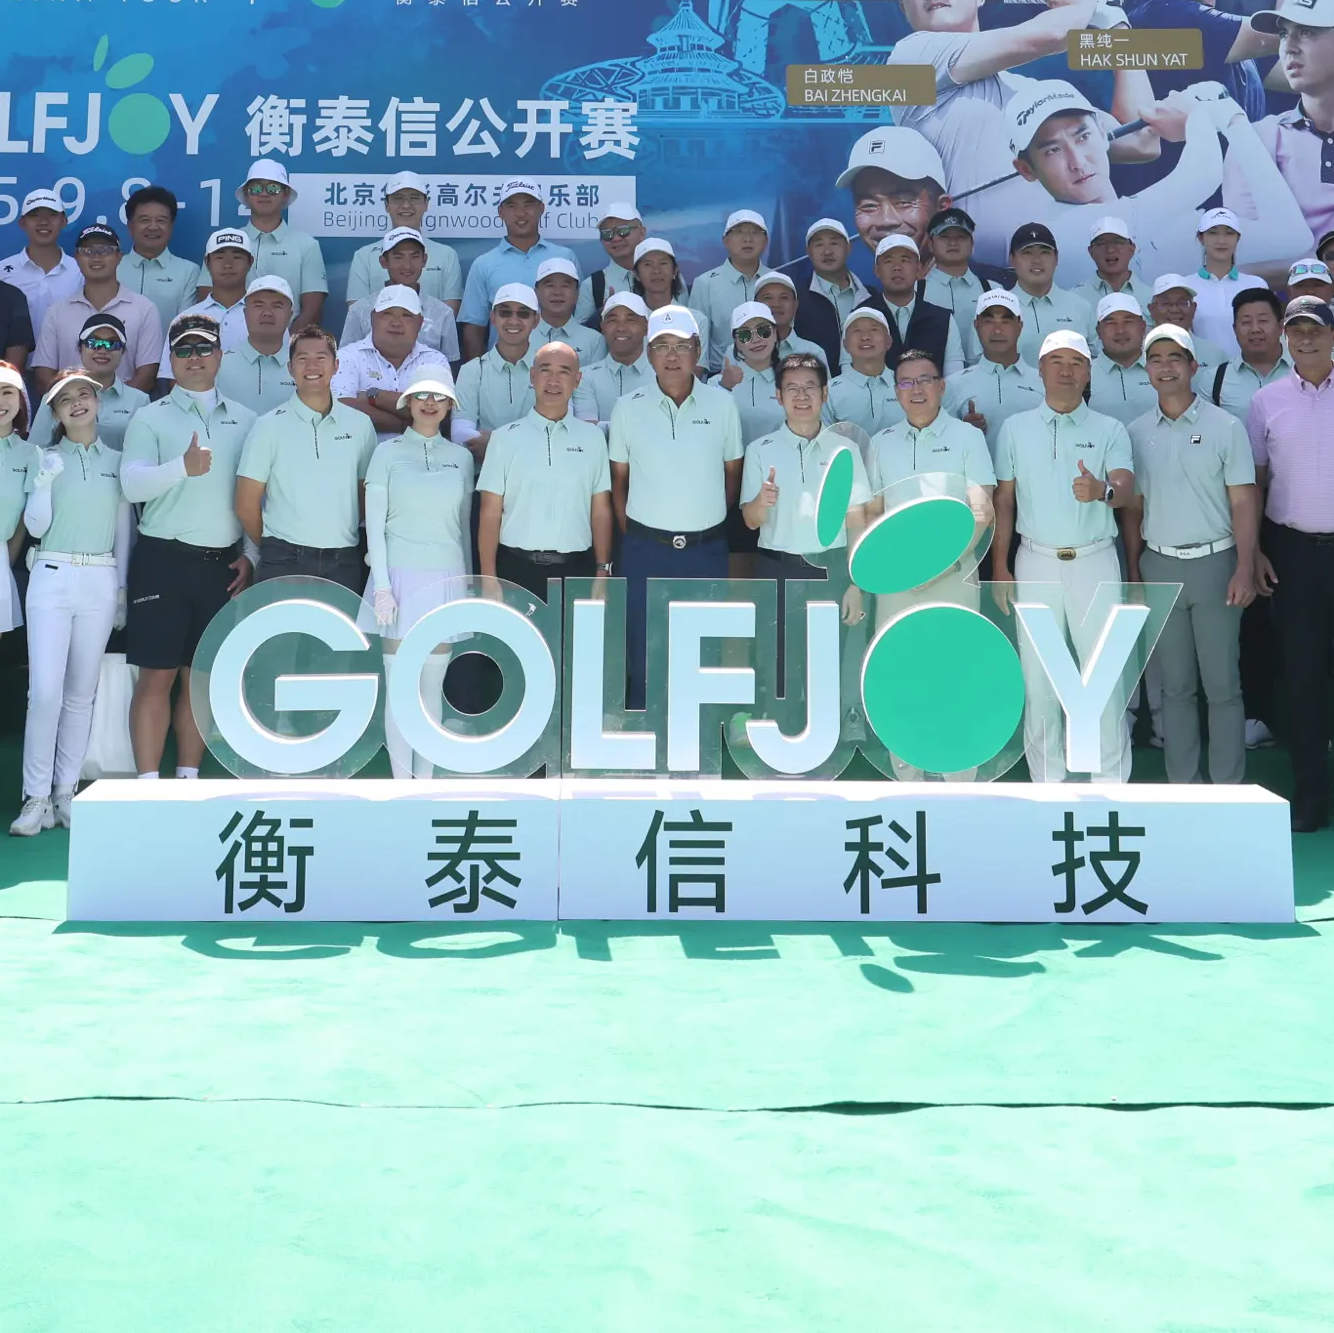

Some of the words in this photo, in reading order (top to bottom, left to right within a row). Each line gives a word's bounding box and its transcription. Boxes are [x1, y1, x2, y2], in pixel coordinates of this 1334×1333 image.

[1079, 33, 1130, 49] 黑纯一
[1079, 53, 1113, 68] HAK
[1116, 53, 1158, 67] SHUN
[1161, 52, 1188, 66] YAT
[804, 69, 854, 85] 白政恺
[804, 89, 829, 103] BAI
[832, 88, 907, 103] ZHENGKAI
[1017, 91, 1075, 126] TaylorMade
[244, 94, 640, 160] 衡泰信公开赛
[323, 211, 388, 231] Beijing
[557, 212, 598, 229] Club
[218, 235, 242, 243] PING
[209, 598, 1151, 774] GOLFJOY
[215, 808, 1150, 916] 衡泰信科技
